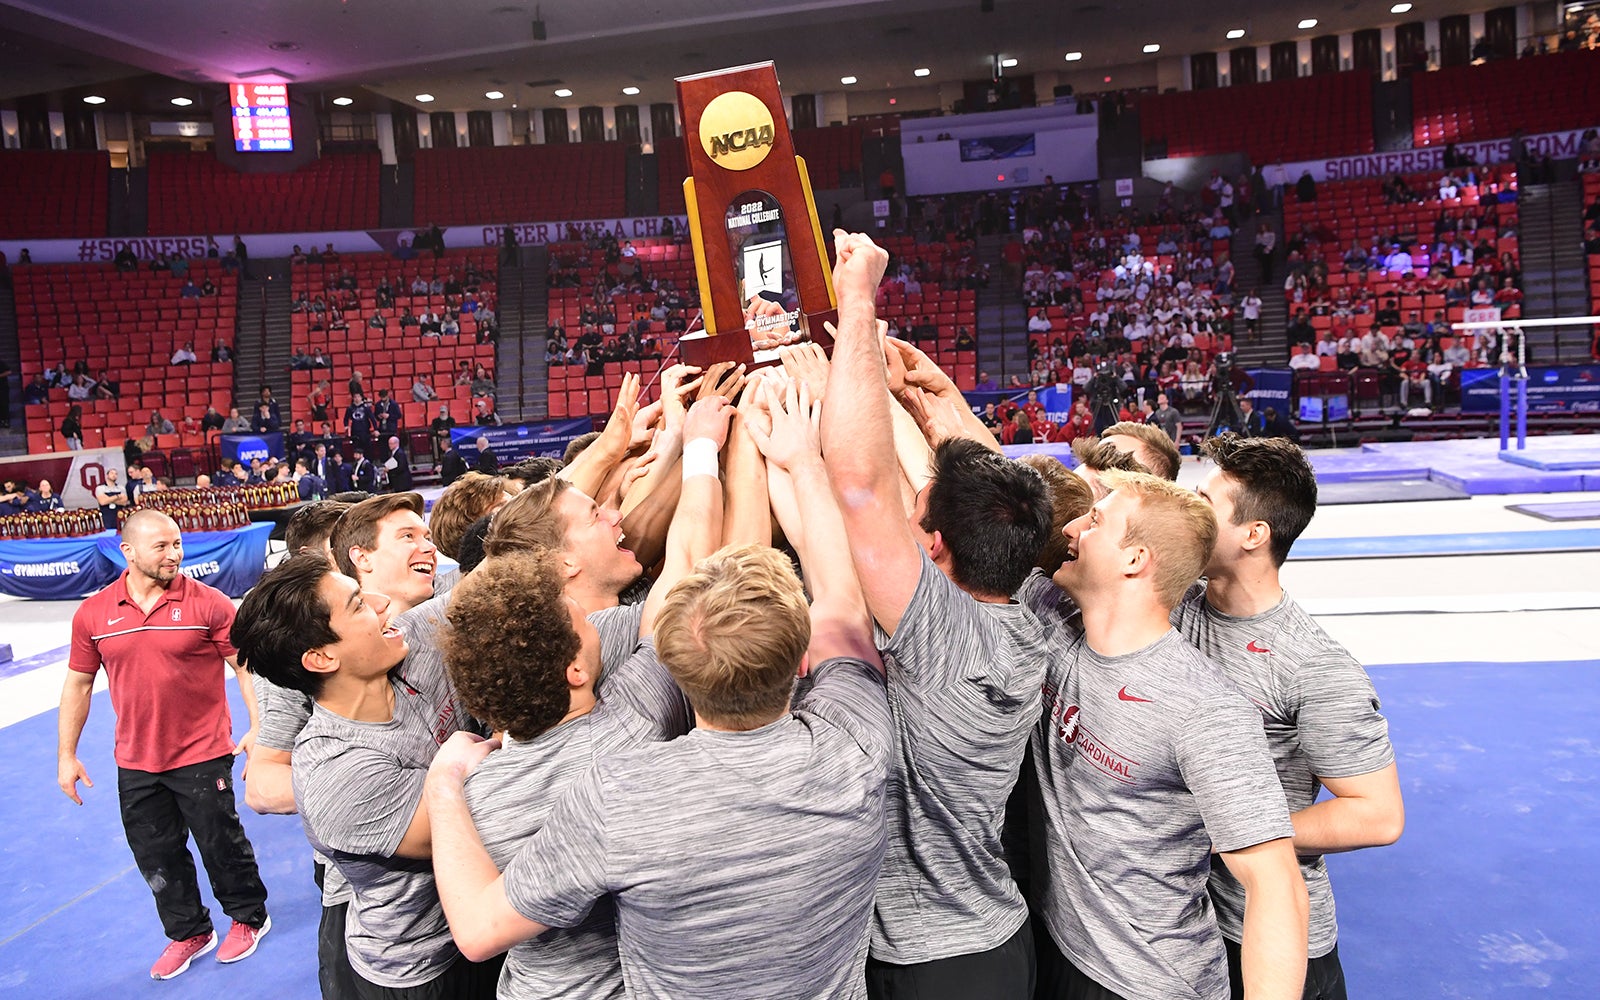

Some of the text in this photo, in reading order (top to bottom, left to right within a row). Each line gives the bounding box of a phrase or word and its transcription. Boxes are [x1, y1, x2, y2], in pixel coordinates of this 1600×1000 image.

[710, 124, 774, 159] NCAA
[741, 201, 763, 215] 2022
[728, 209, 780, 229] NATIONAL COLLEGIATE
[756, 310, 799, 327] GYMNASTICS
[1046, 411, 1069, 423] TICS
[240, 449, 269, 461] NCAA
[13, 561, 80, 577] GYMNASTICS
[178, 560, 220, 578] STICS
[1076, 732, 1133, 779] CARDINAL
